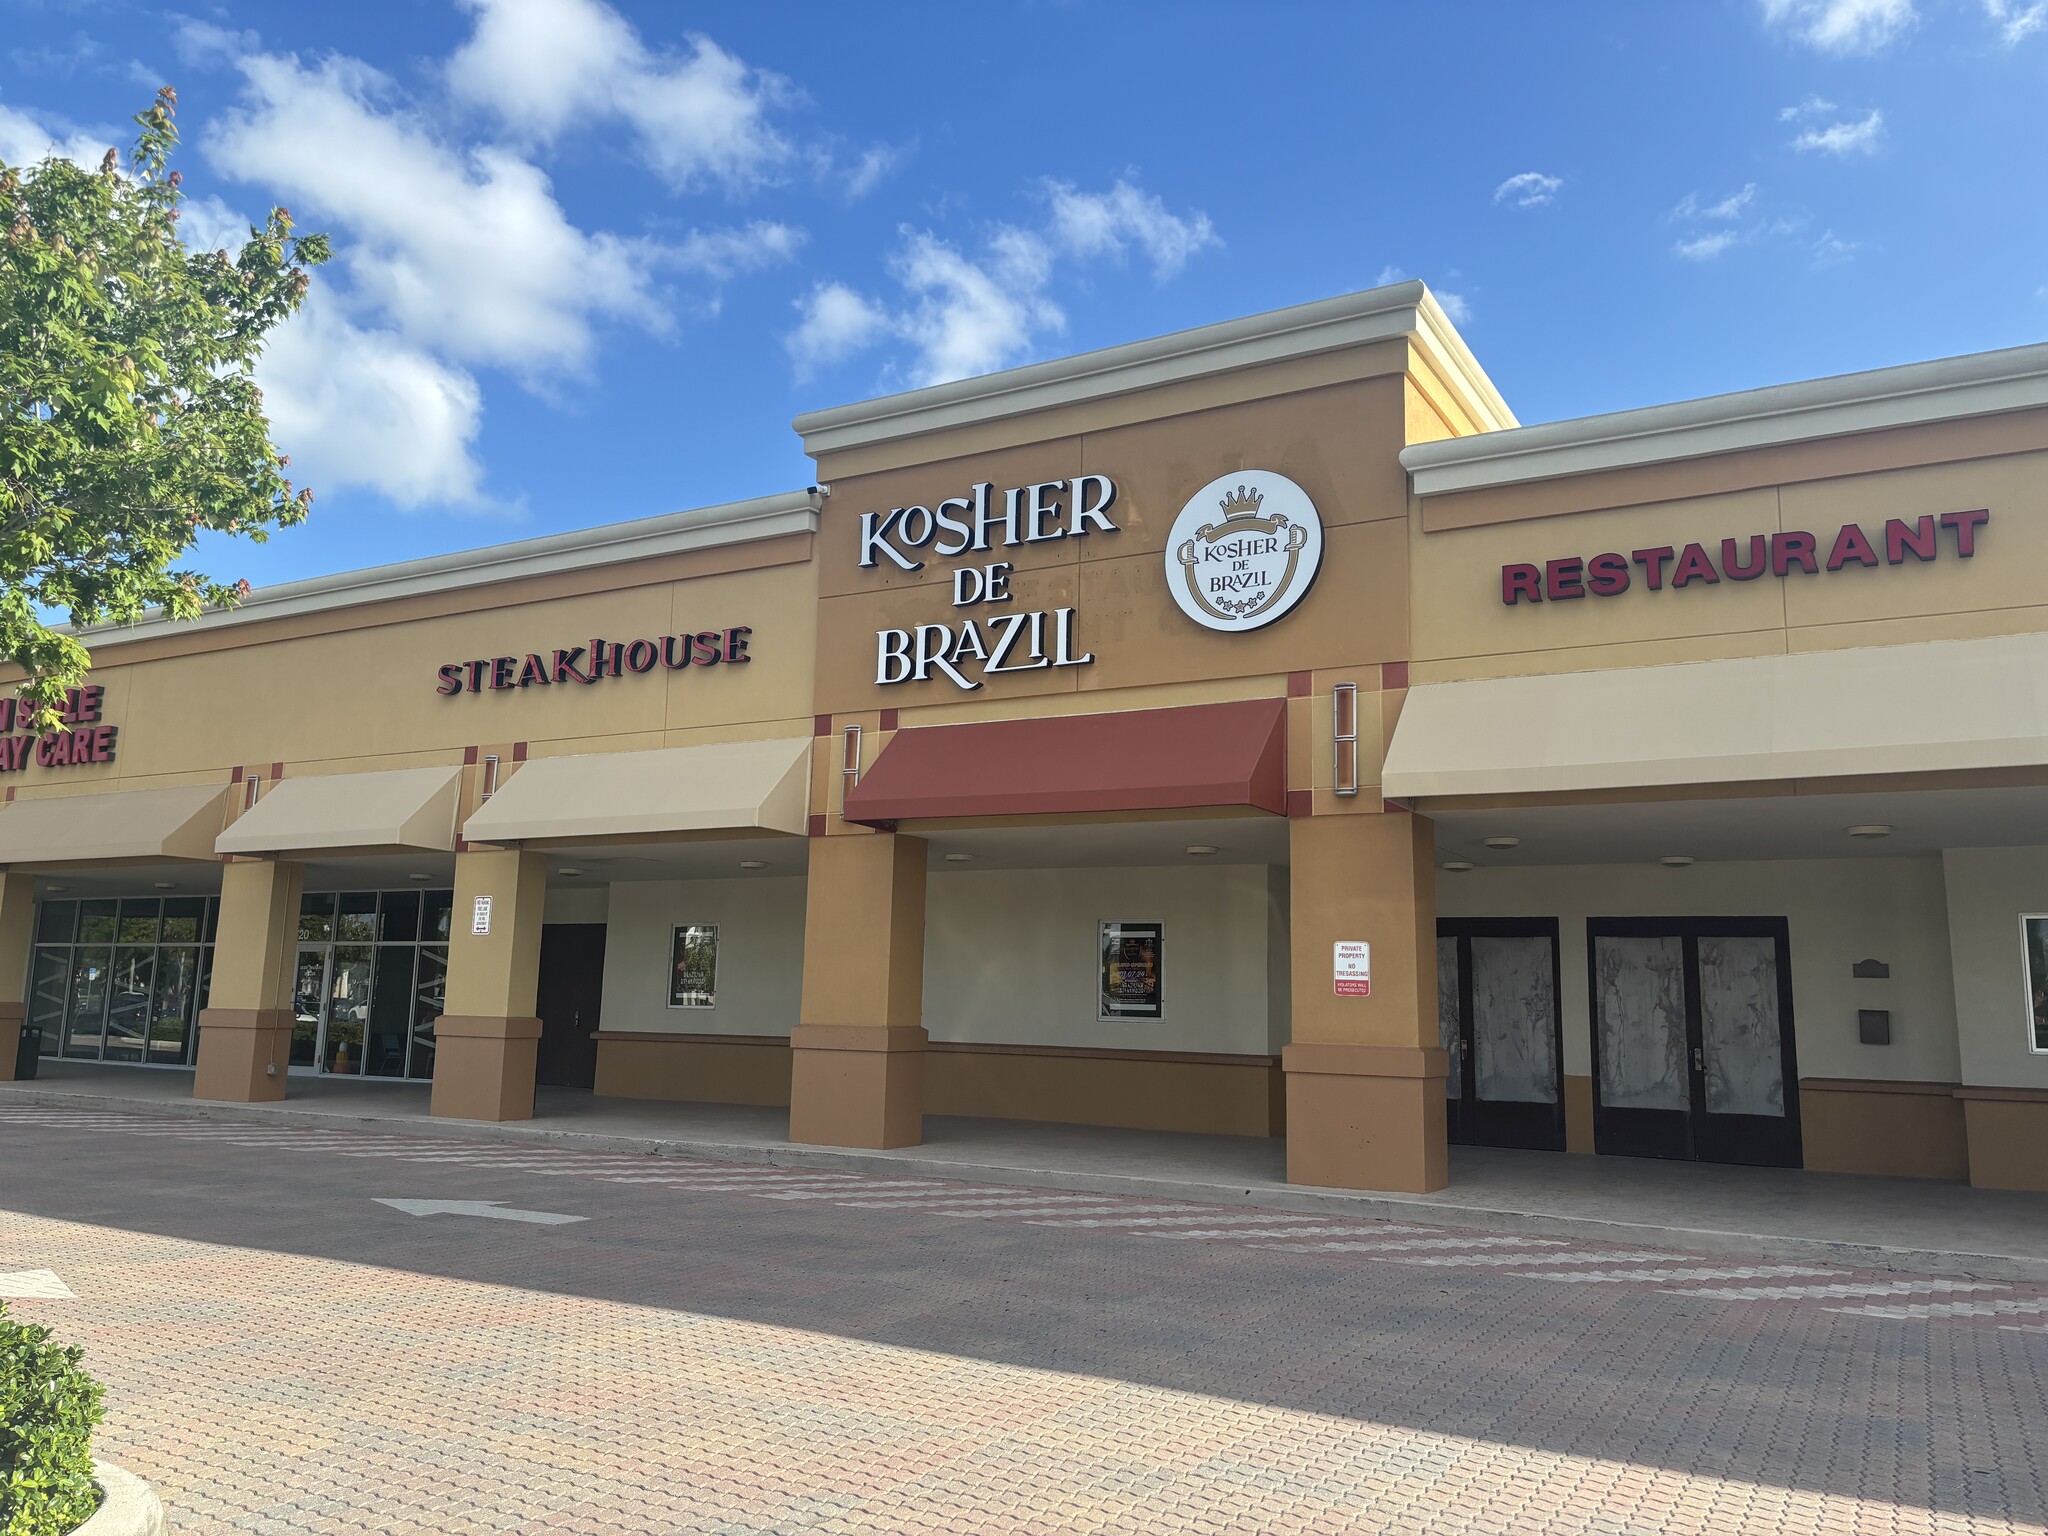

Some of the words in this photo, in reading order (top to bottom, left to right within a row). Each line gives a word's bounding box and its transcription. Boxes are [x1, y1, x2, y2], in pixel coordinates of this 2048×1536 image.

[857, 474, 1121, 571] KOSHER
[1204, 538, 1278, 562] KOSHER
[1232, 560, 1250, 571] DE
[1501, 509, 1989, 605] RESTAURANT
[952, 562, 1013, 607] DE
[1210, 571, 1272, 592] BRAZIL
[436, 626, 752, 696] STEAKHOUSE
[875, 607, 1094, 690] BRAZIL
[36, 725, 118, 767] CARE
